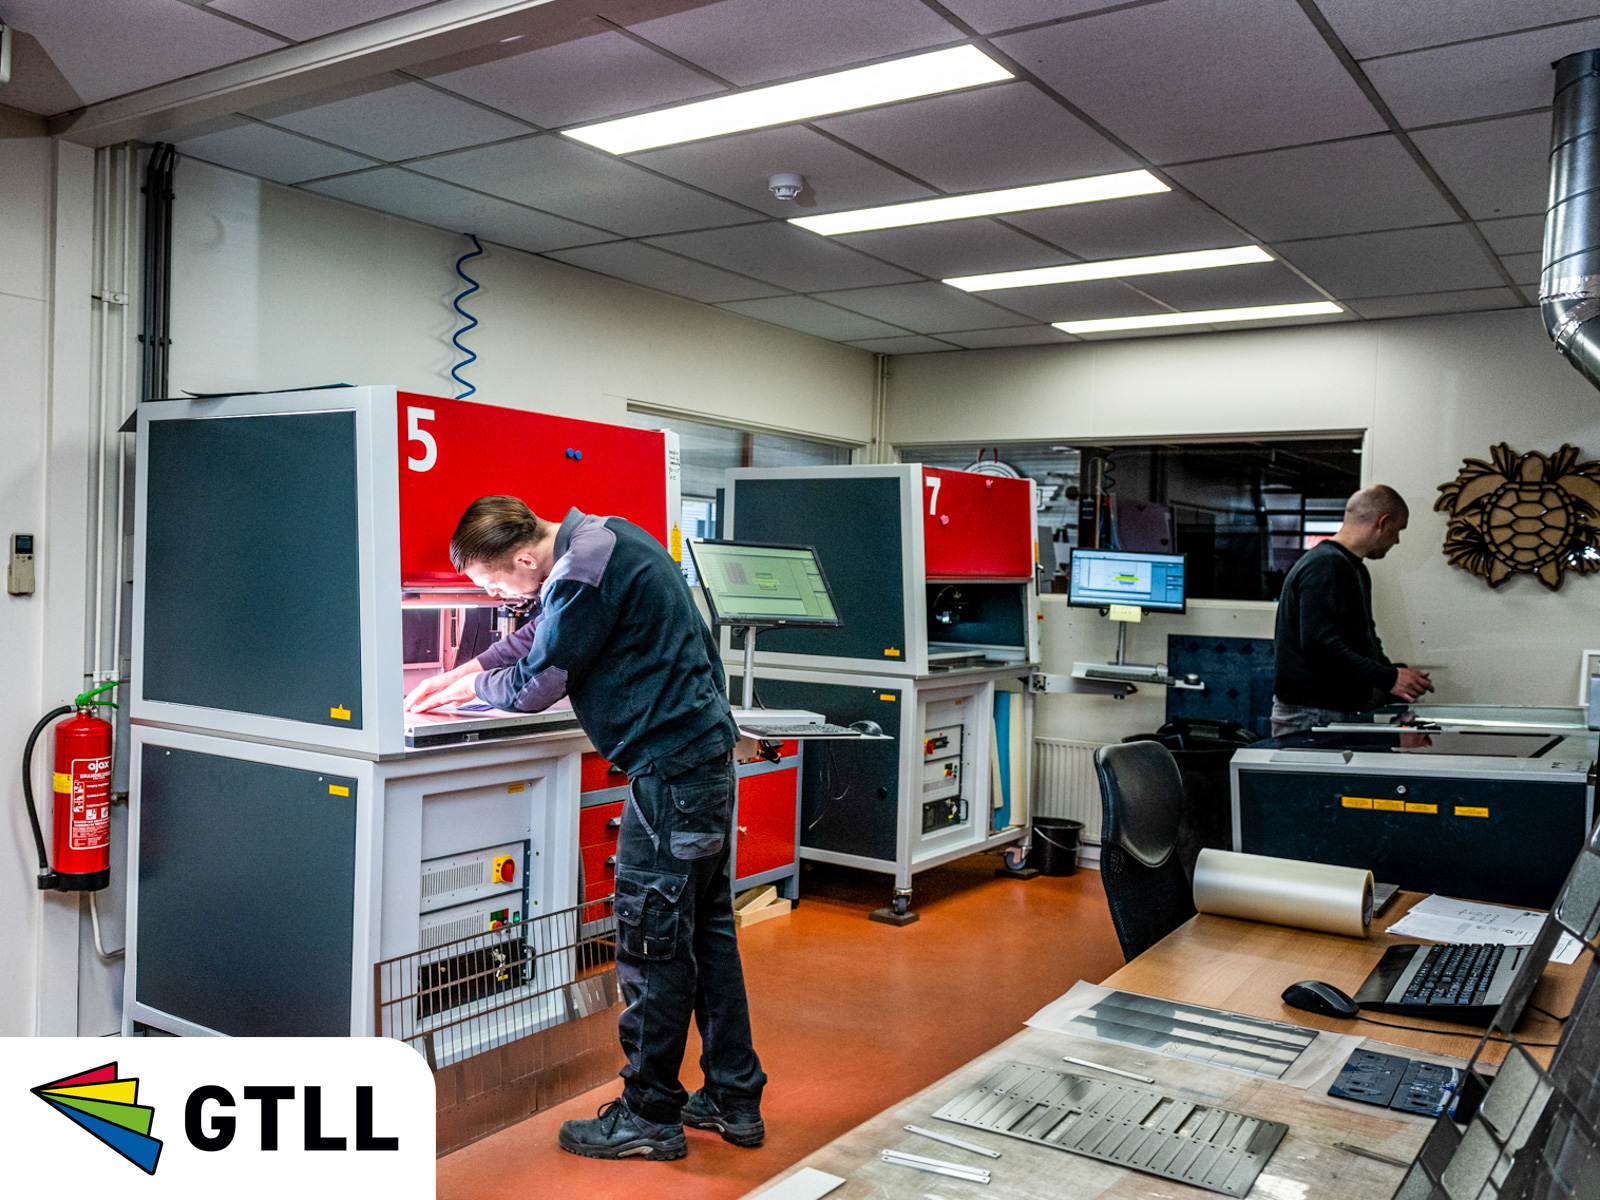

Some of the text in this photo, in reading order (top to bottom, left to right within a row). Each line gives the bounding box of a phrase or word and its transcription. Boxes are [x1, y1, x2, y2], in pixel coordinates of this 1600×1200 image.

[407, 405, 437, 473] 5
[925, 476, 941, 516] 7
[87, 759, 110, 774] ajax
